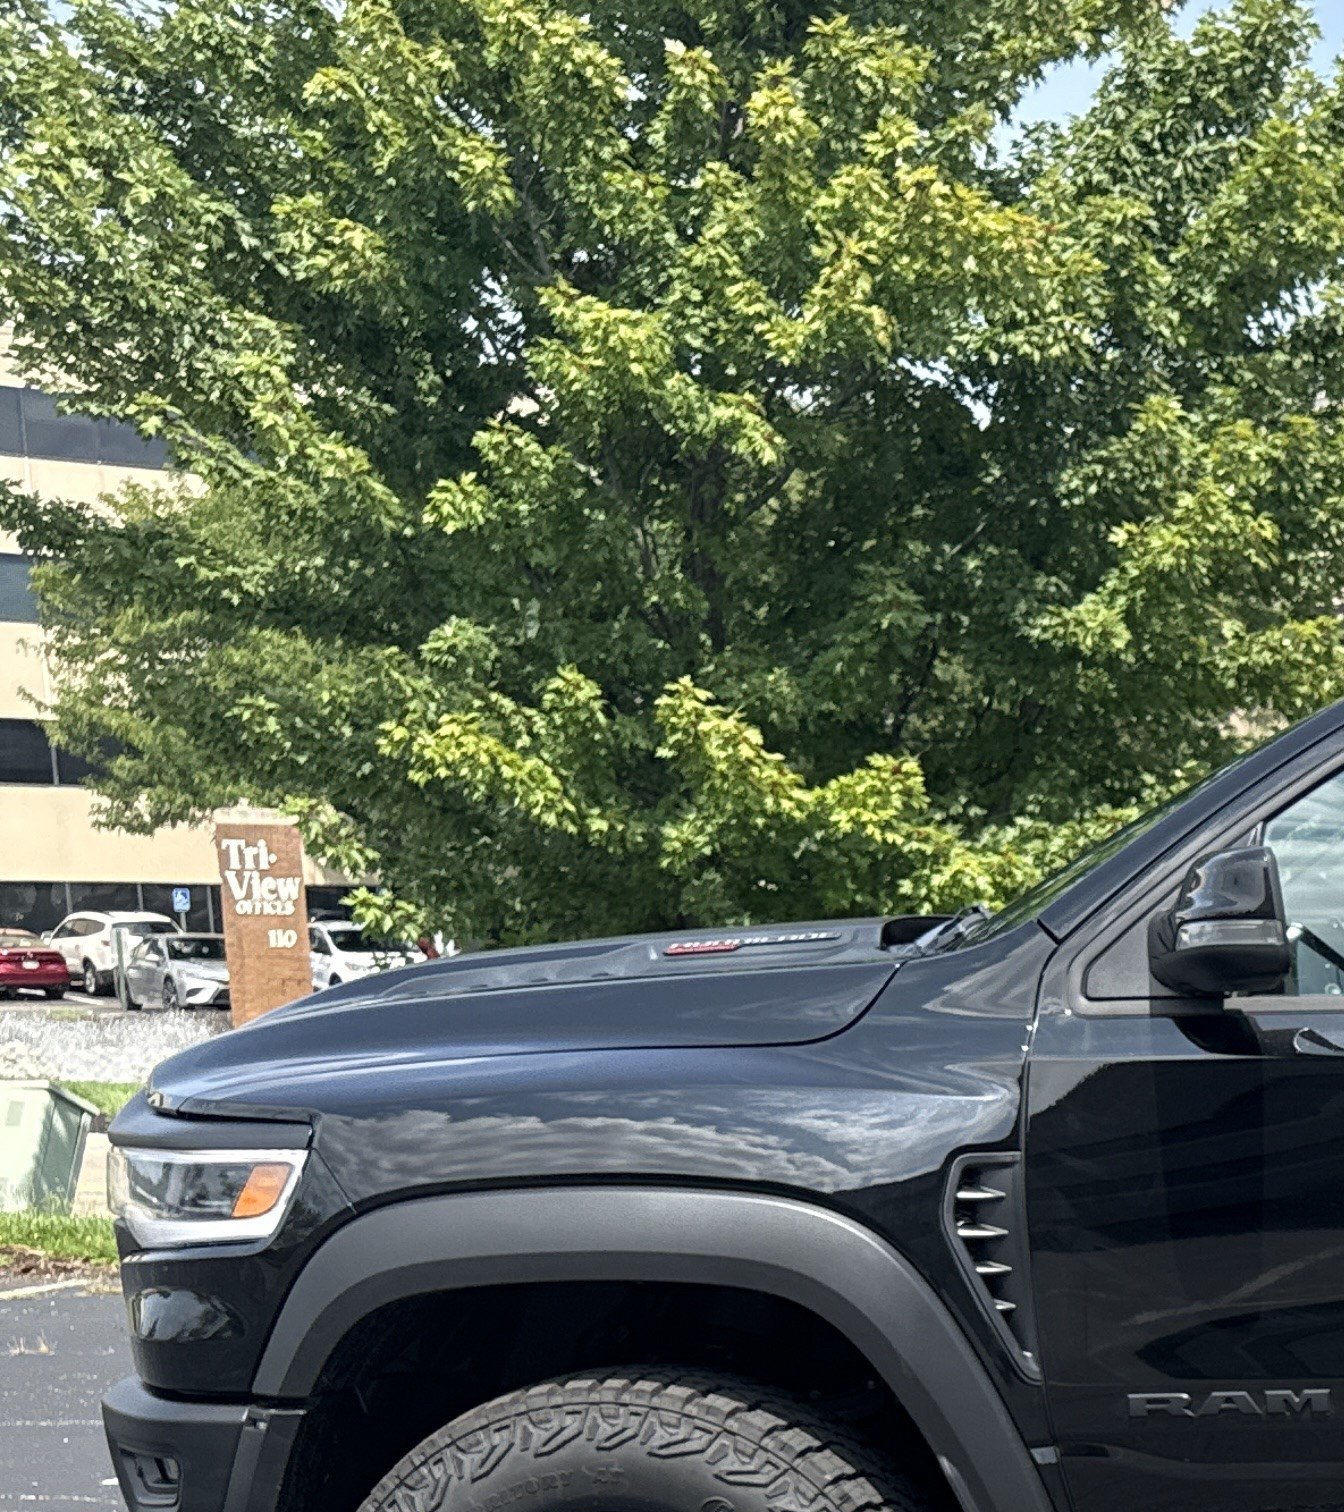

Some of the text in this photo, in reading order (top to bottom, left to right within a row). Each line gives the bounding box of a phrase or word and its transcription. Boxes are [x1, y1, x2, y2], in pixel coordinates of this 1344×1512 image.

[225, 870, 302, 901] View
[267, 928, 298, 949] 110
[1126, 1388, 1334, 1418] RAM
